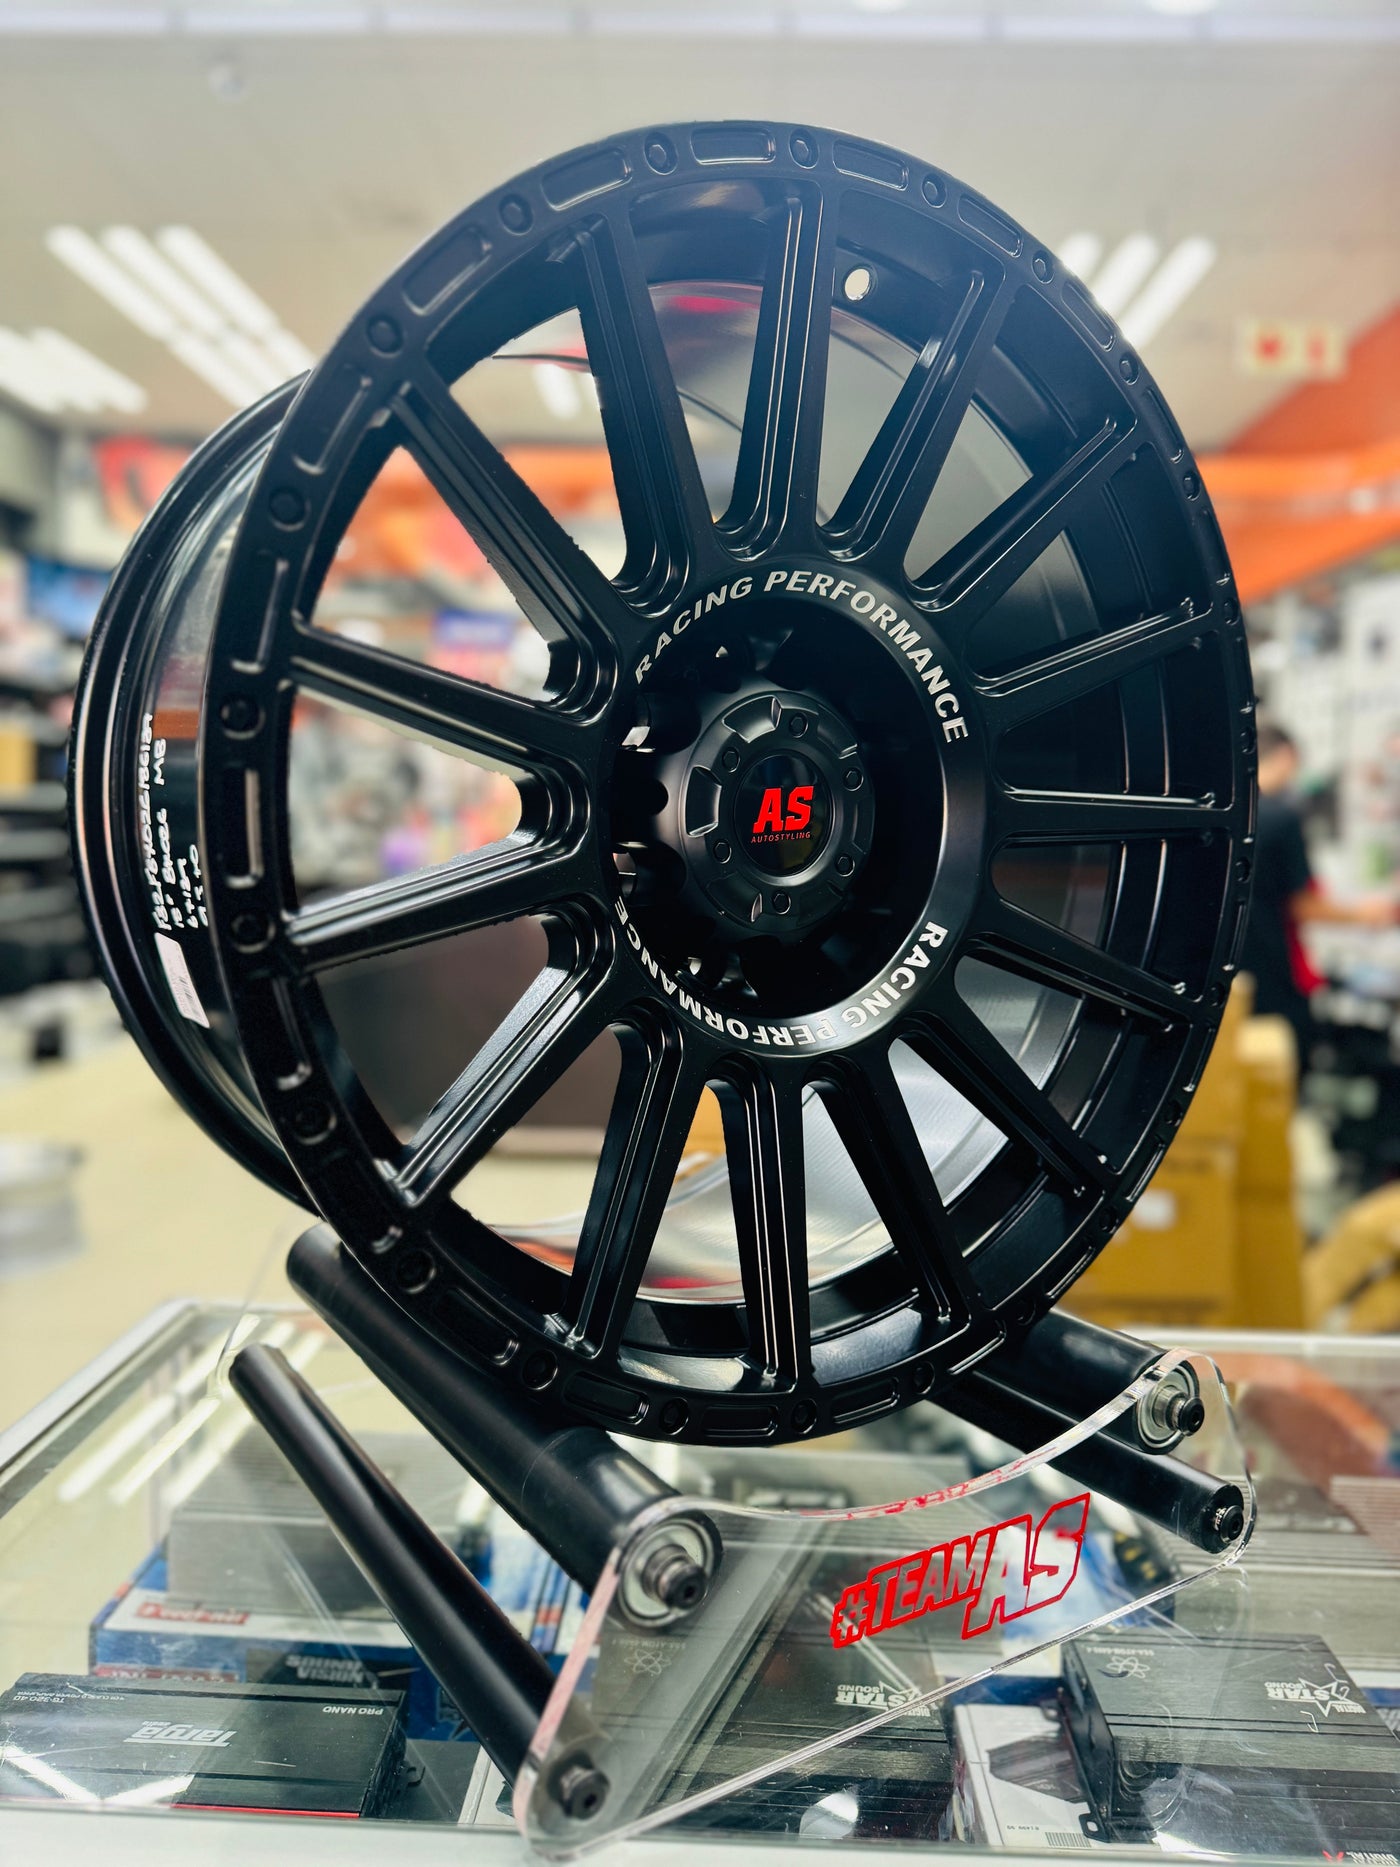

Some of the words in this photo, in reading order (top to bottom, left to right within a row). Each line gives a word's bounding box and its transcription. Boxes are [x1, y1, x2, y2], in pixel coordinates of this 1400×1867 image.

[634, 576, 753, 684] RACING
[764, 570, 969, 743] PERFORMANCE
[753, 786, 814, 833] AS
[750, 831, 811, 844] AUTOSTYLING
[614, 896, 838, 1047] PERFORMANCE
[850, 920, 949, 1029] RACING
[838, 1684, 880, 1694] SOUND
[1264, 1681, 1304, 1689] SOUND
[835, 1691, 907, 1707] STAR
[1266, 1687, 1331, 1700] STAR
[322, 1705, 357, 1715] NANO
[358, 1706, 384, 1716] PRO
